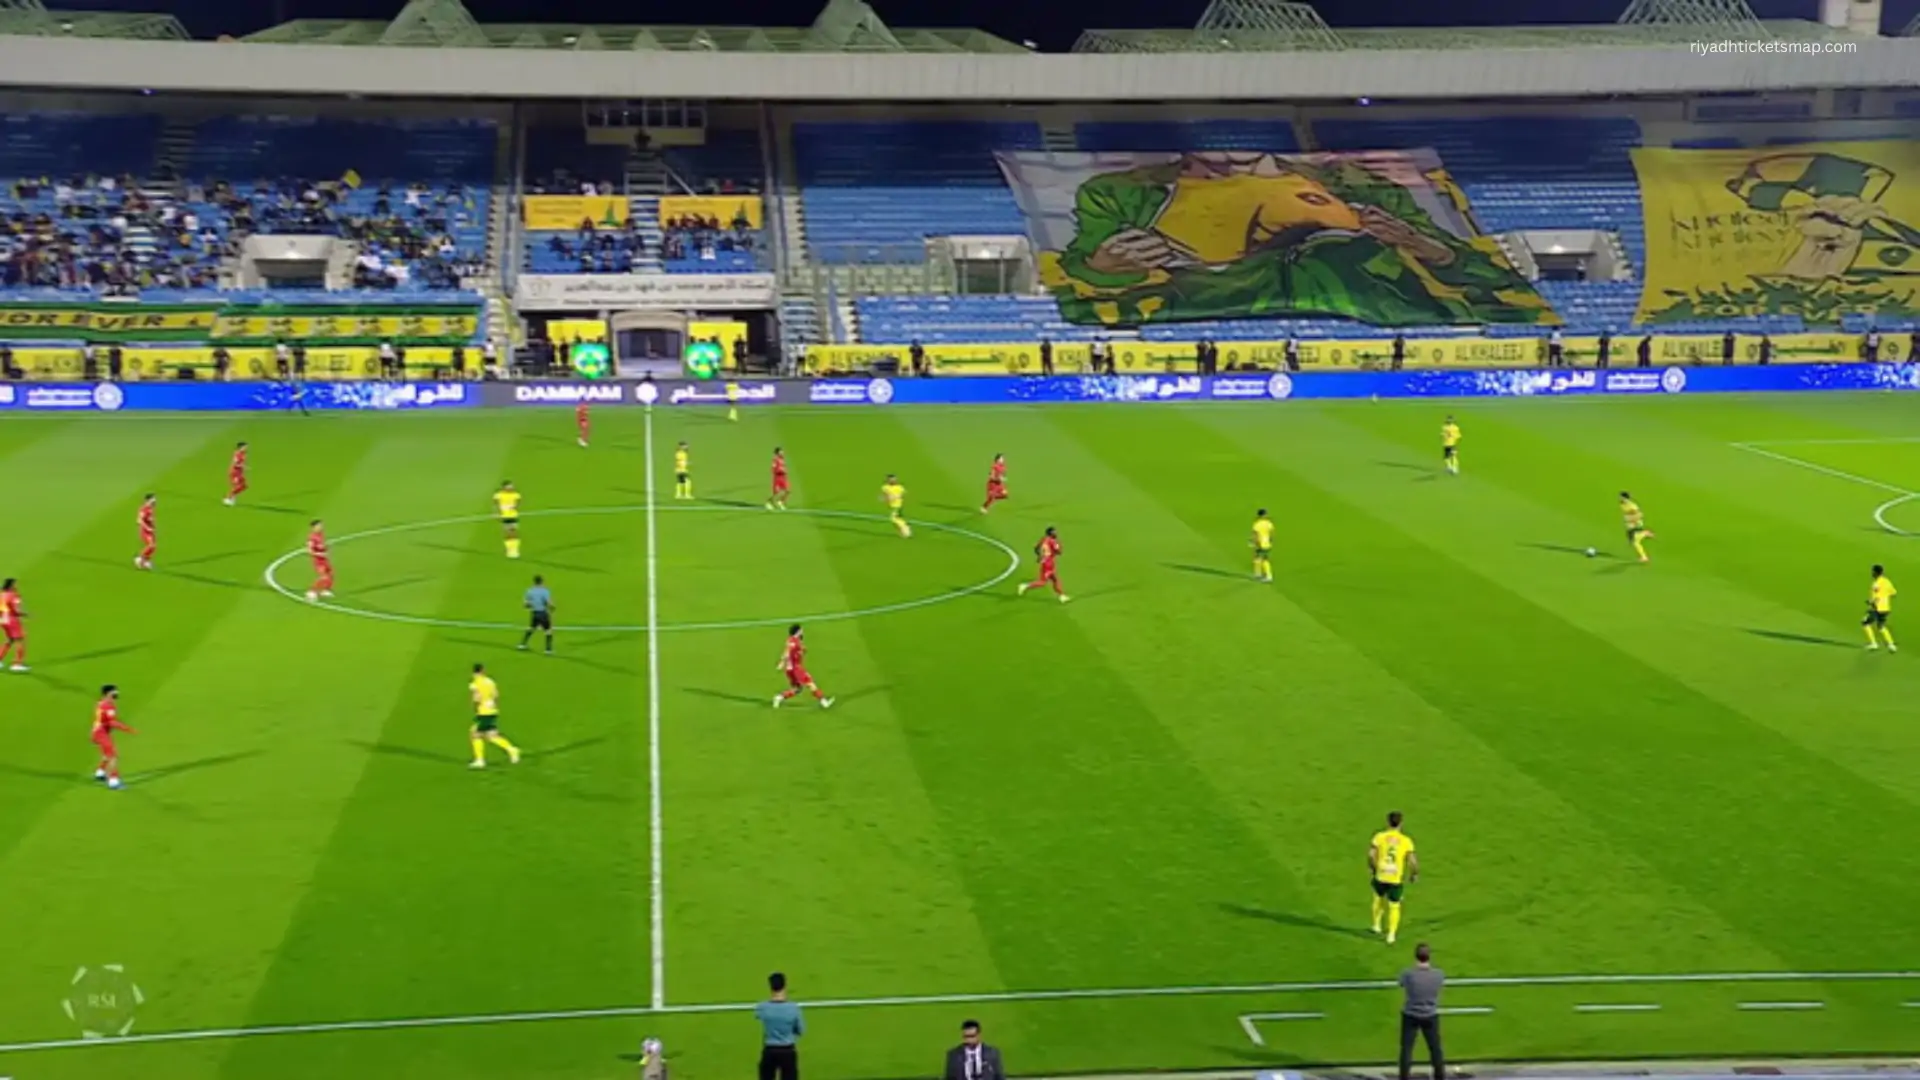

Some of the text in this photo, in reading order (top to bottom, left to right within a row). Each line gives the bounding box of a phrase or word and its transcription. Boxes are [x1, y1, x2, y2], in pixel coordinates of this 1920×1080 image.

[0, 311, 164, 330] OR EVER
[515, 386, 622, 401] DAMMAM
